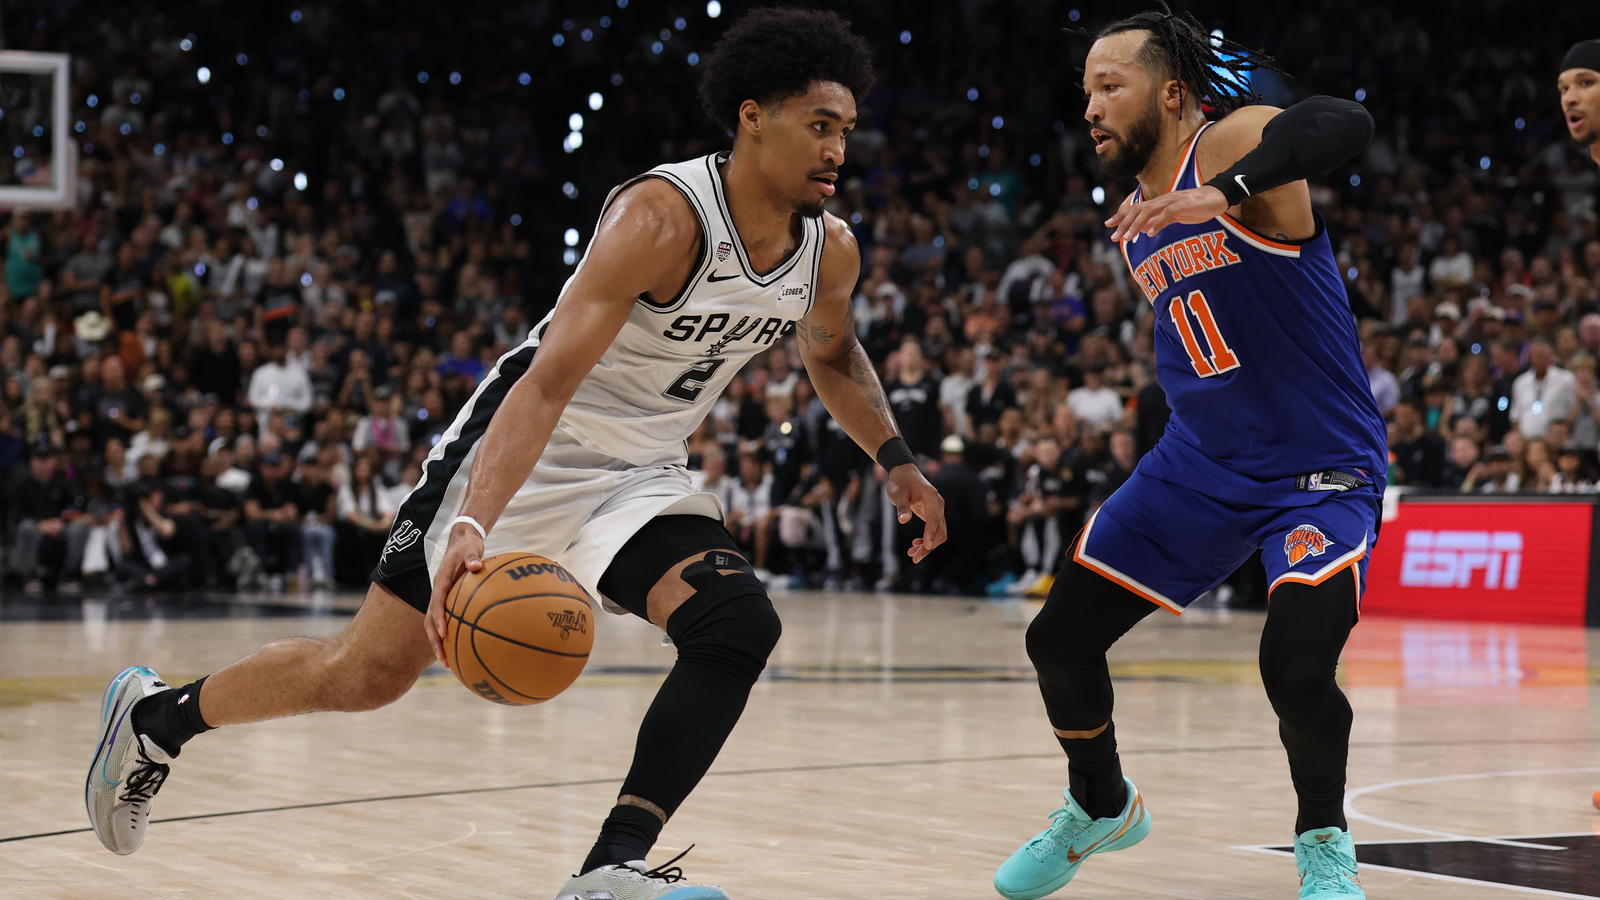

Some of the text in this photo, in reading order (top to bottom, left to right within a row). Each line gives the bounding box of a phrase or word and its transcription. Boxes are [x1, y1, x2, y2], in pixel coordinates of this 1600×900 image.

[1159, 229, 1242, 283] YORK
[782, 287, 804, 296] LEDGER
[1168, 289, 1242, 379] 11
[662, 358, 728, 404] 2
[1285, 529, 1324, 552] KNICKS
[505, 563, 582, 589] ilson
[1400, 530, 1523, 589] ESPN
[546, 610, 583, 631] Finals
